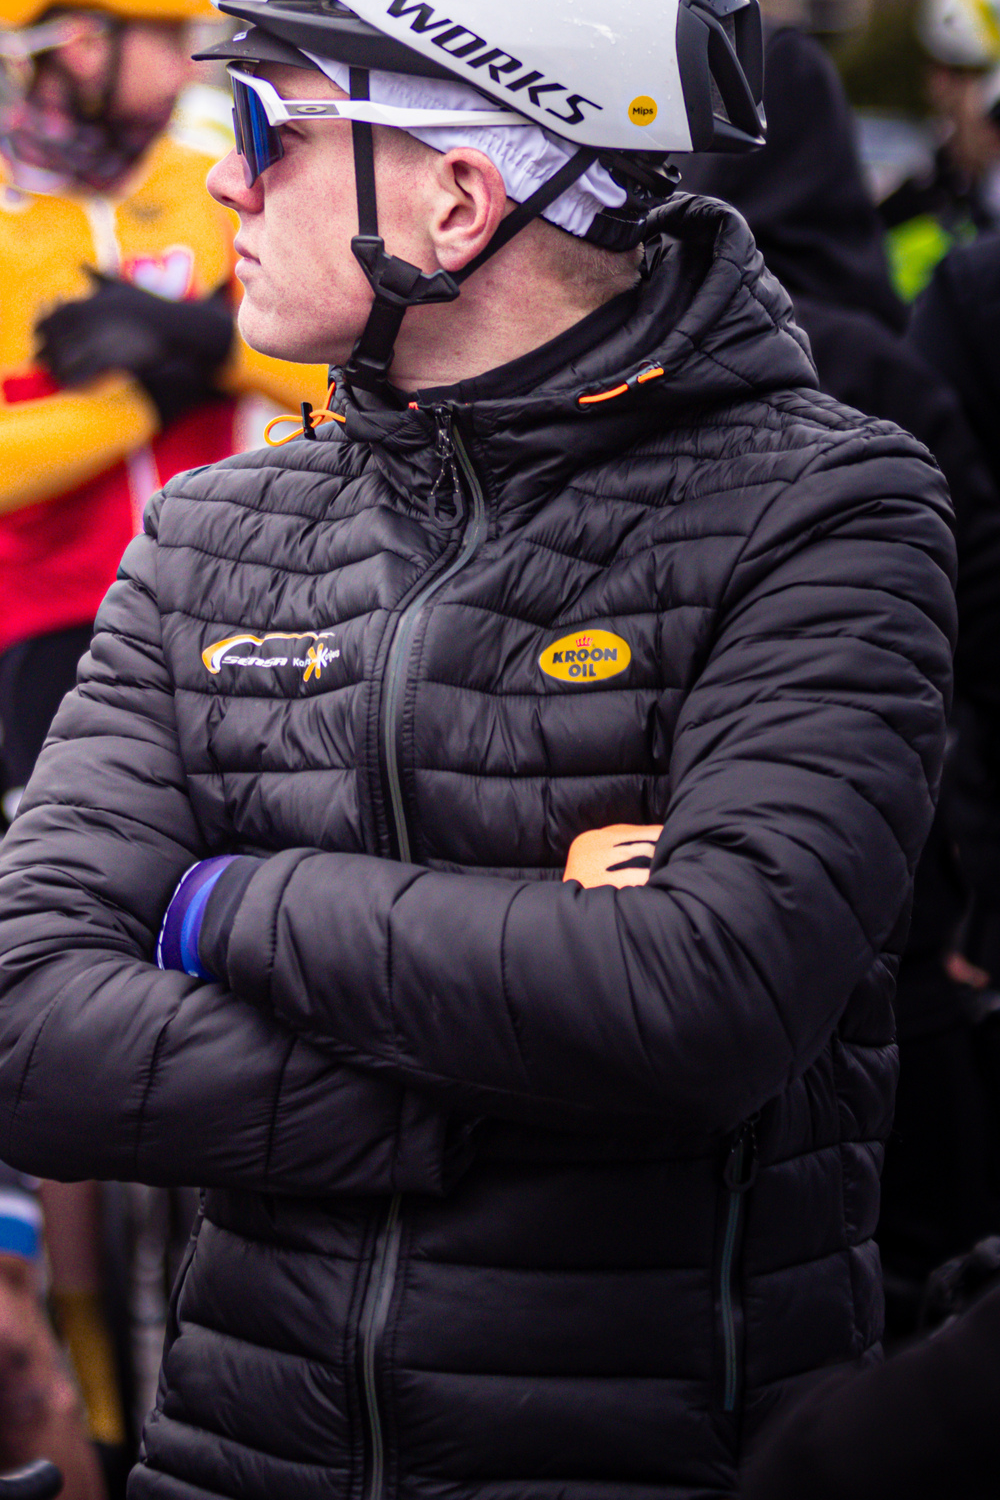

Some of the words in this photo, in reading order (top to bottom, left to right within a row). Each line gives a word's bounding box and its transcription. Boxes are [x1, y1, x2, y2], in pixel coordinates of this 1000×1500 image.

[632, 106, 654, 116] Mips
[552, 647, 618, 664] KROON
[568, 663, 597, 678] OIL
